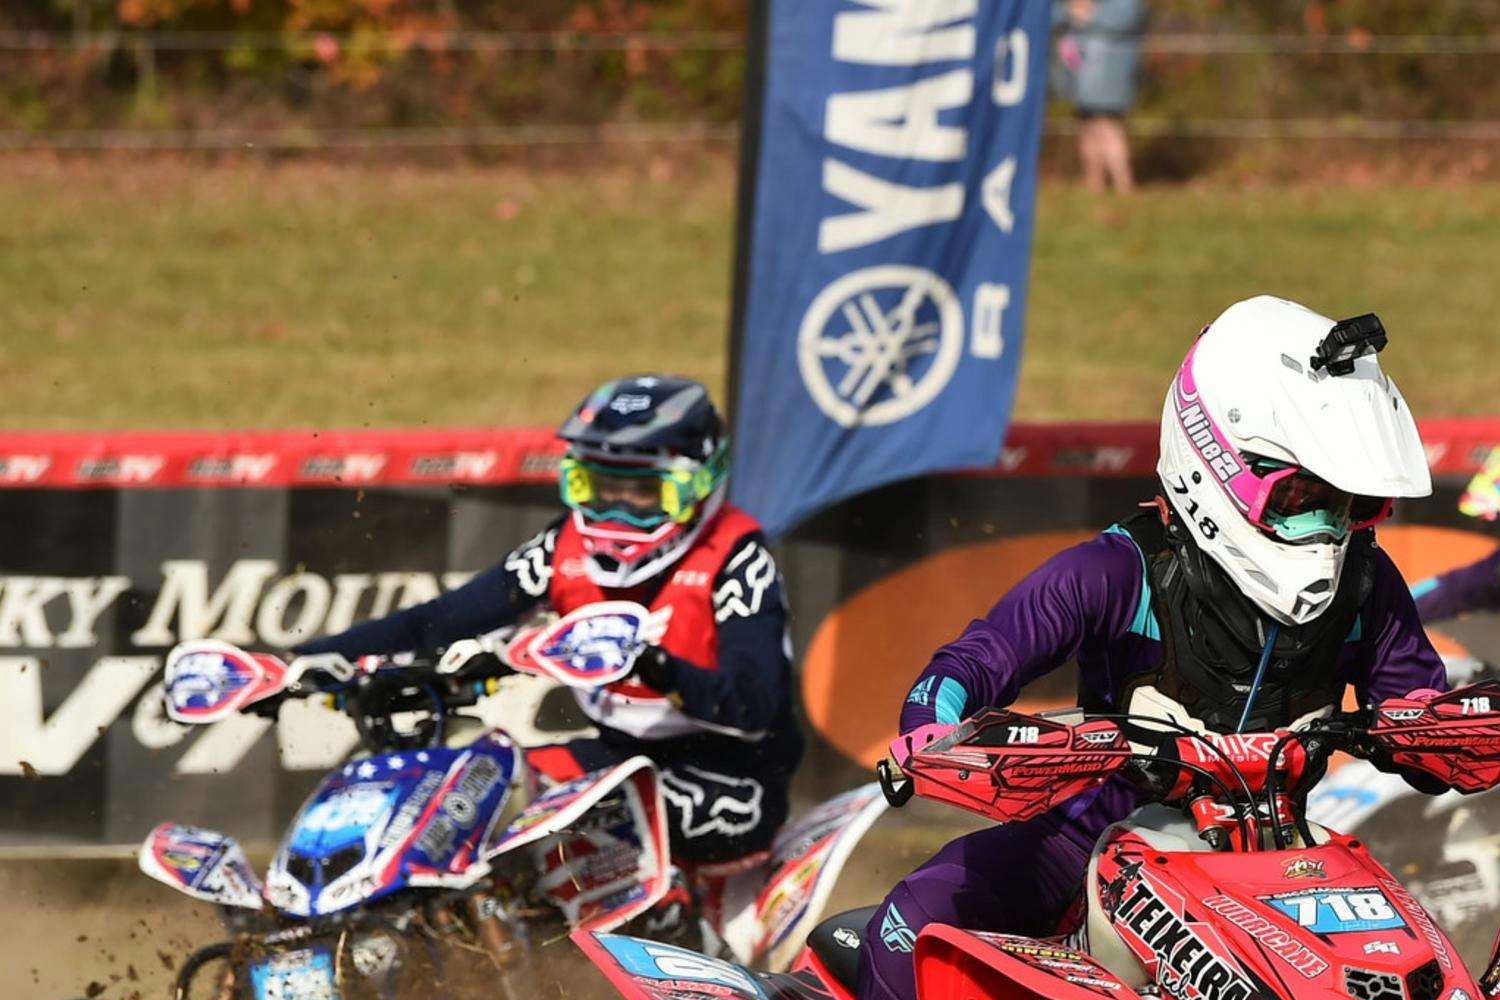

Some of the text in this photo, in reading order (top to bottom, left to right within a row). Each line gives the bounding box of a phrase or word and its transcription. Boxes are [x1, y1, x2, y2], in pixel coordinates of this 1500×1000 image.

[1180, 403, 1242, 484] Nine2
[1172, 474, 1220, 540] 718
[1460, 697, 1491, 714] 718
[1007, 726, 1039, 744] 718
[1283, 892, 1396, 927] 718
[1201, 893, 1329, 979] HURRICANE
